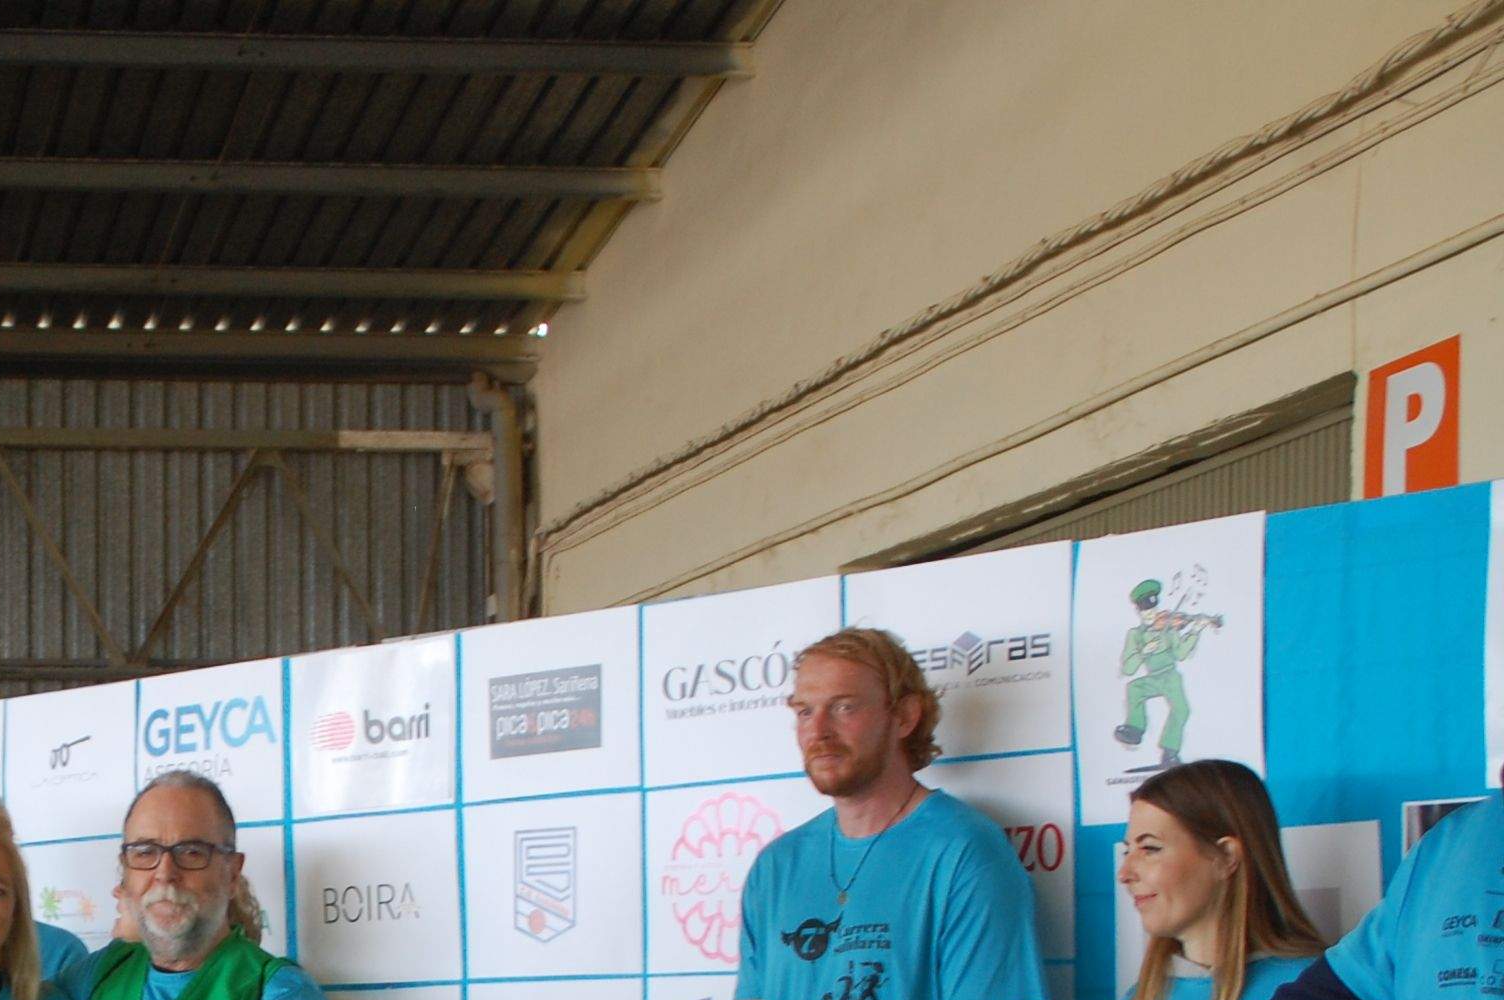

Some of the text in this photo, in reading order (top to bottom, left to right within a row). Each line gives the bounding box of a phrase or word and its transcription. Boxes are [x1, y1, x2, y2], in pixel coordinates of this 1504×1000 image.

[1380, 361, 1446, 497] P
[144, 695, 278, 757] GEYCA
[323, 882, 420, 924] BOIRA
